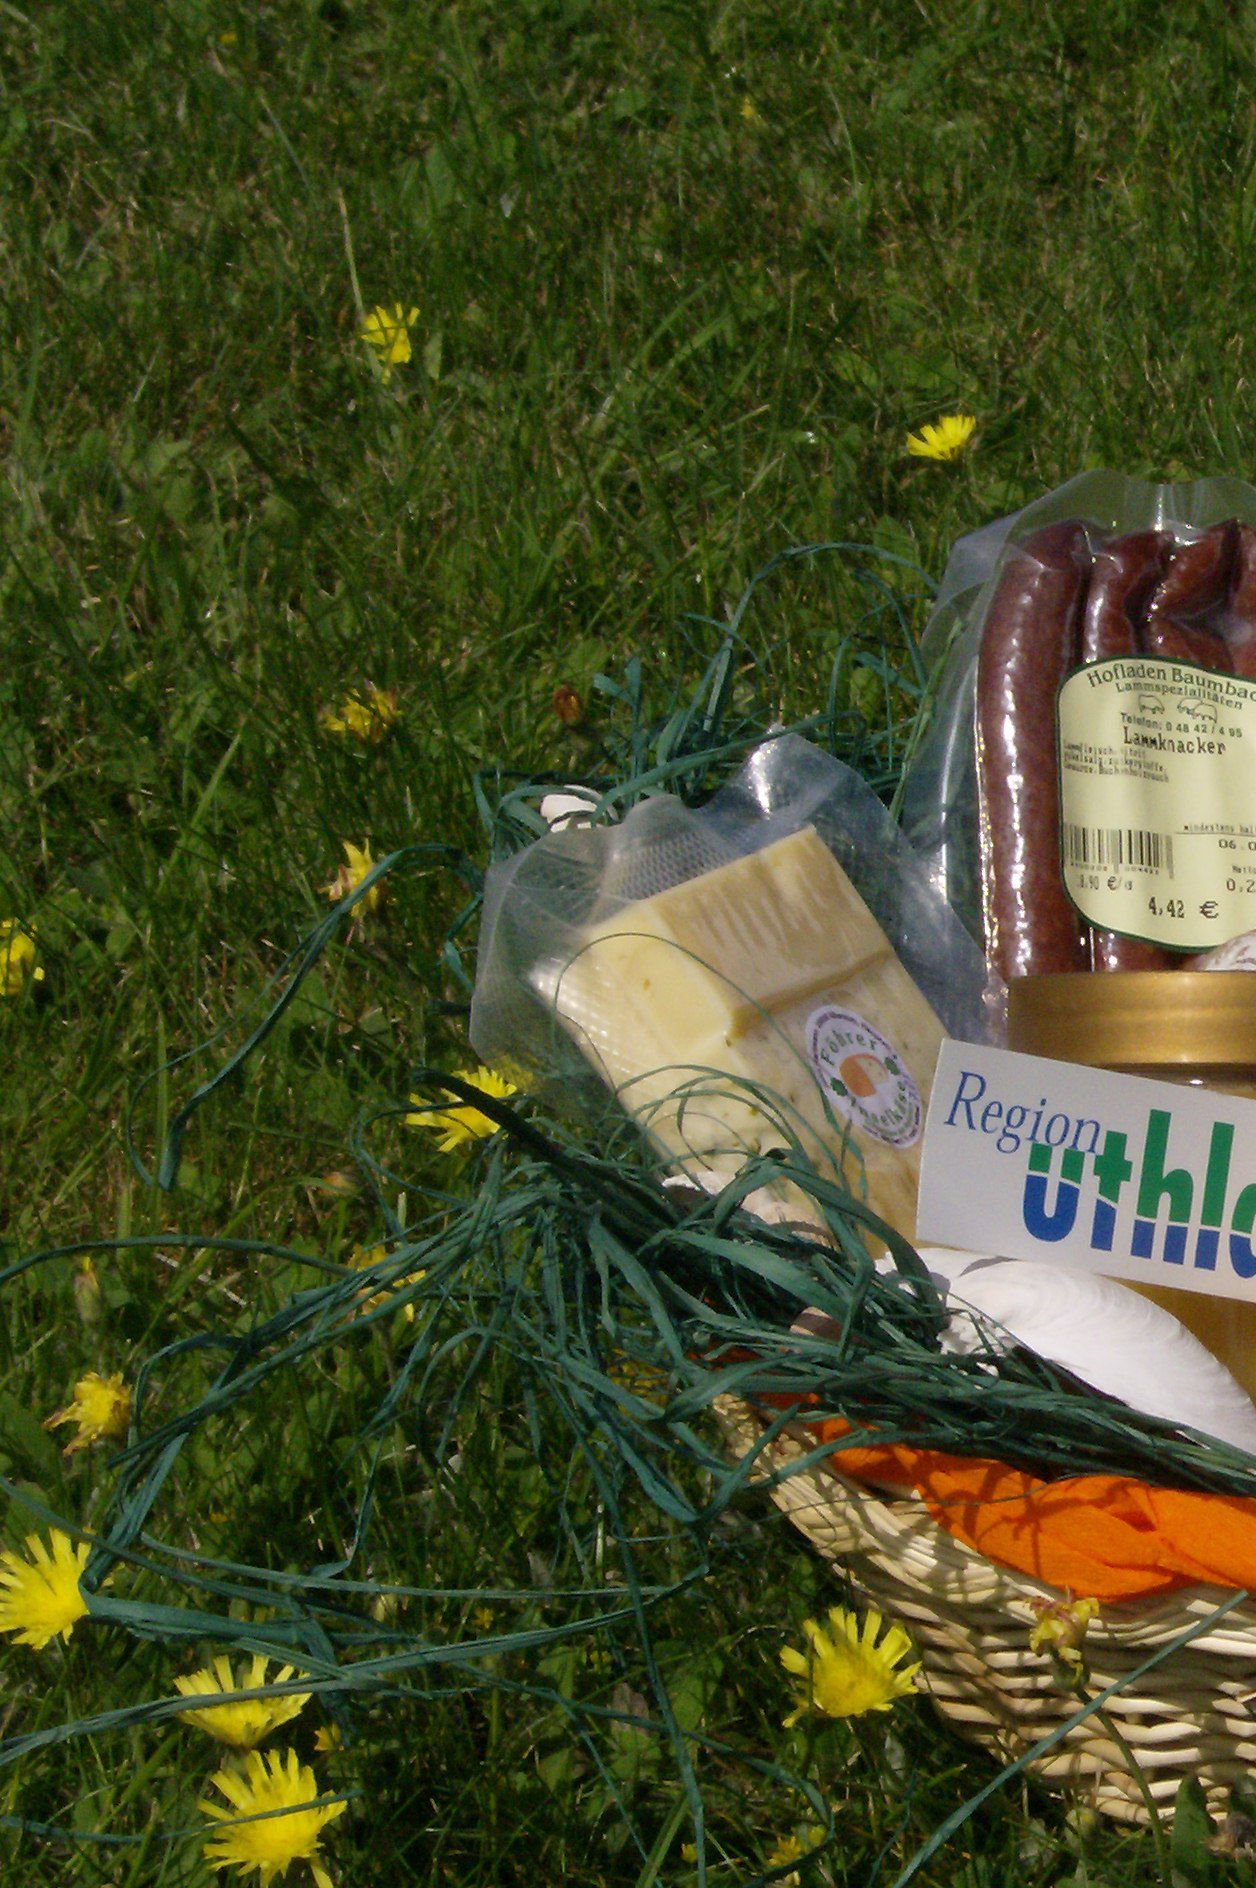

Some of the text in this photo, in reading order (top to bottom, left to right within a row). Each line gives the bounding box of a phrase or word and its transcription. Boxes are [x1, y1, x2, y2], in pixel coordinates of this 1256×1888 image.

[1088, 663, 1167, 688] Hofladen
[1176, 723, 1189, 733] 48
[1193, 723, 1207, 734] 42
[1149, 897, 1219, 919] 4,42 €
[944, 1071, 1100, 1154] Region
